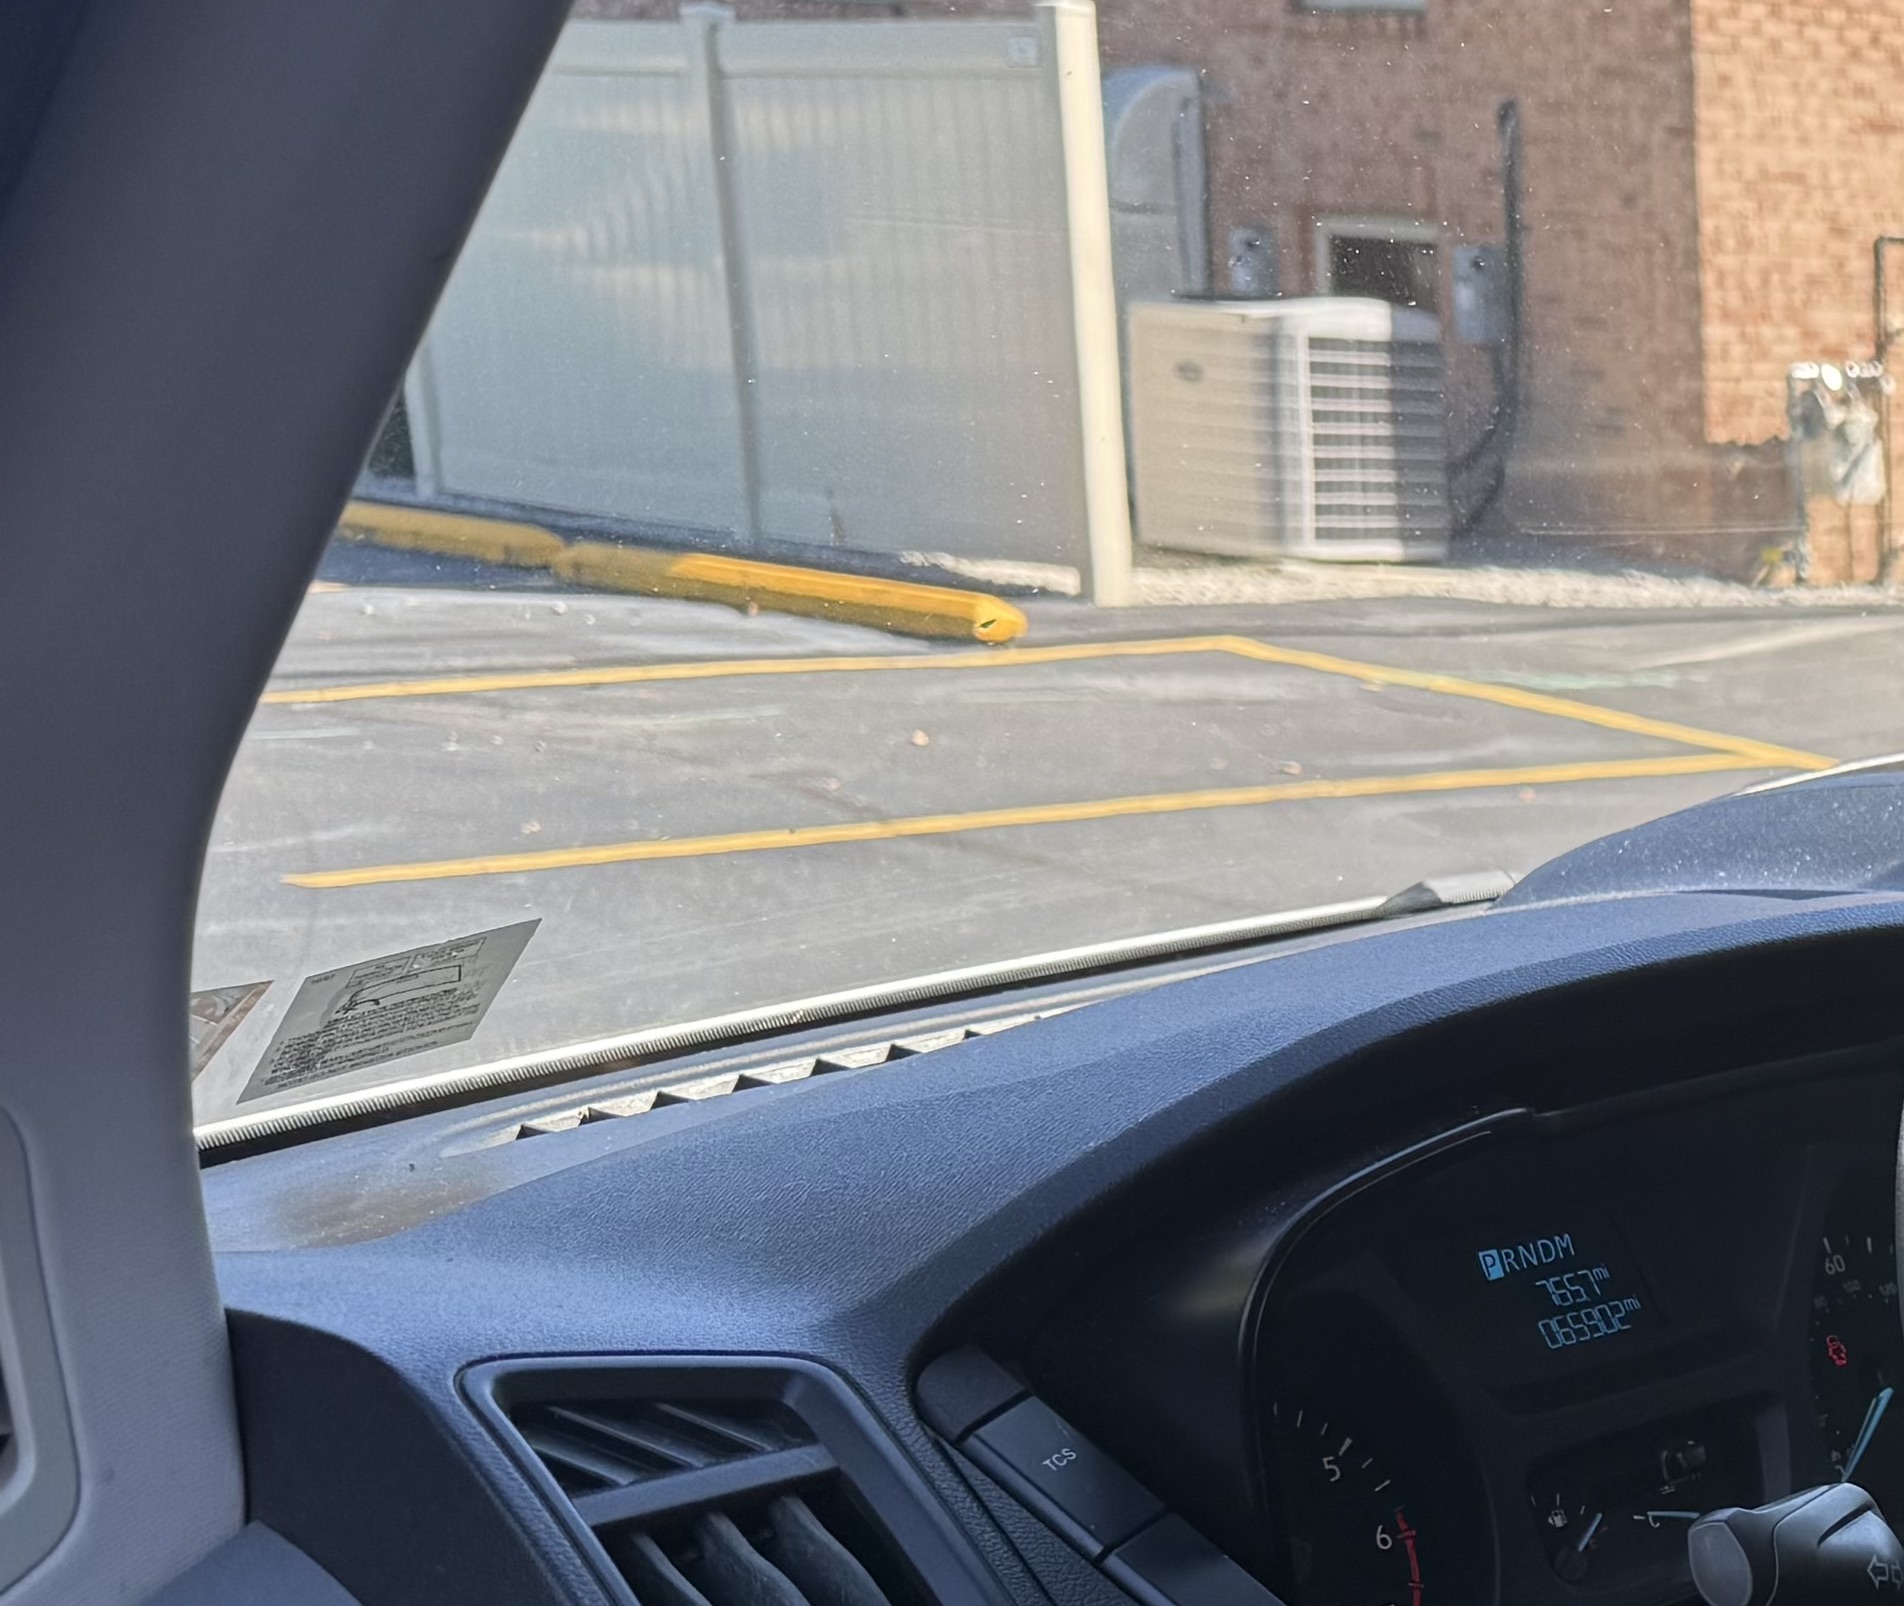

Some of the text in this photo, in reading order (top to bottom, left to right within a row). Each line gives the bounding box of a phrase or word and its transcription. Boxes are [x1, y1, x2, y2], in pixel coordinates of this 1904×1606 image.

[1824, 1254, 1846, 1275] 60
[1538, 1304, 1632, 1349] 065902
[1042, 1448, 1077, 1471] TCS
[1322, 1456, 1341, 1482] 5
[1376, 1525, 1392, 1550] 6
